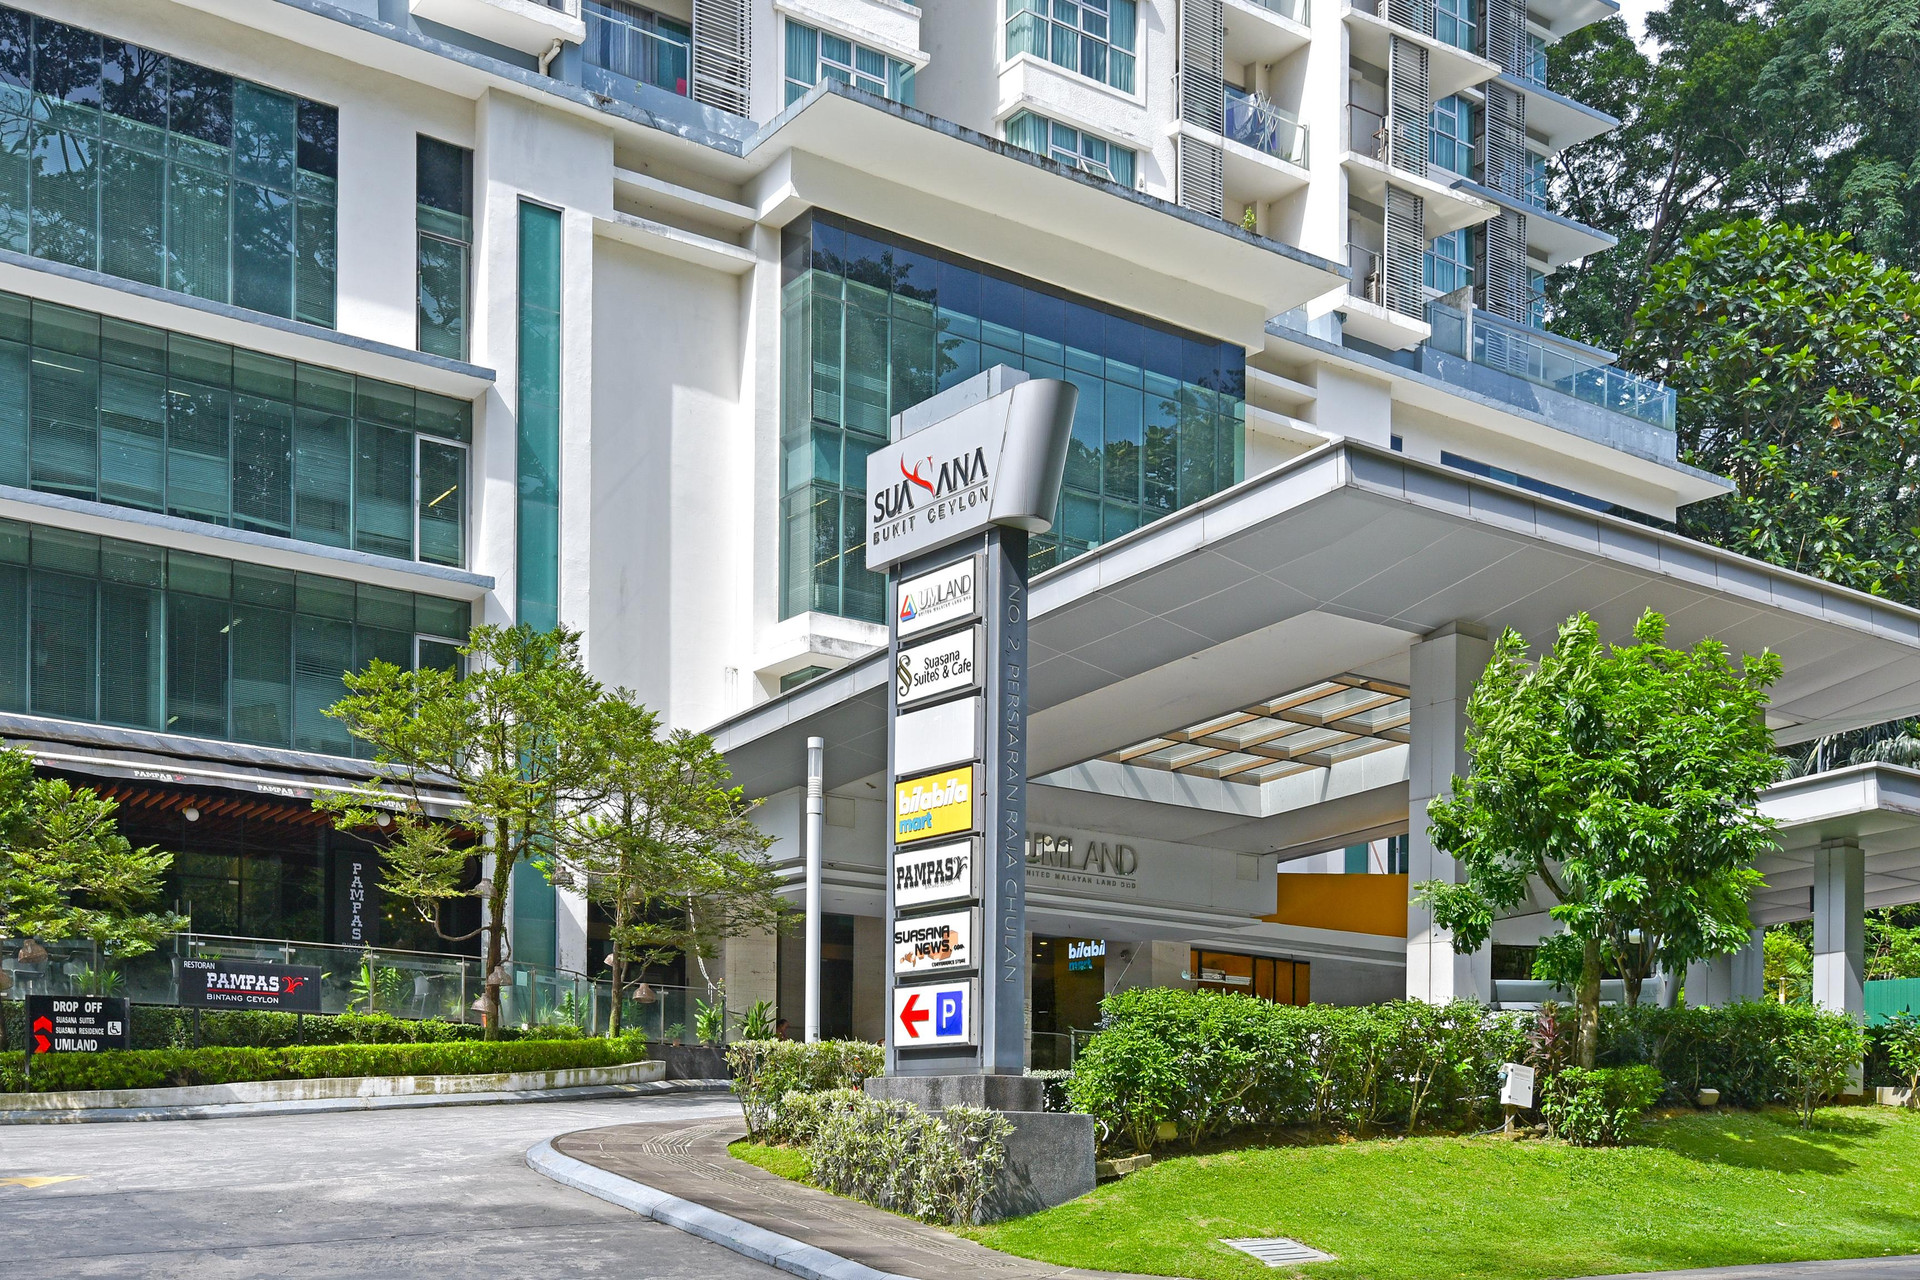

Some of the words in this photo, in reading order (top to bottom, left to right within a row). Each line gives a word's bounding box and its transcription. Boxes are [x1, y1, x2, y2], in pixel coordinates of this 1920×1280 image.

[874, 446, 988, 524] SUASANA
[873, 515, 916, 546] BUKIT
[928, 486, 989, 523] CEYLON
[919, 574, 972, 610] UMLAND
[1008, 584, 1020, 627] NO.
[1005, 636, 1020, 656] 2,
[924, 650, 960, 670] Suasana
[942, 664, 949, 678] &
[952, 658, 972, 675] Cafe
[1006, 663, 1020, 802] PERSIARAN
[134, 770, 173, 780] PAMPAS
[257, 785, 293, 794] PAMPAS
[899, 778, 968, 815] bilabila
[899, 812, 932, 834] mart
[1006, 810, 1018, 869] RAJA
[1025, 832, 1138, 876] UMLAND
[897, 857, 953, 890] PAMPAS
[1026, 870, 1050, 878] NITED
[1054, 874, 1092, 883] MALAYAN
[1096, 878, 1116, 886] LAND
[350, 862, 364, 940] PAMPAS
[895, 925, 950, 944] SUASANA
[1004, 878, 1018, 983] CHULAN
[183, 960, 215, 970] RESTORAN
[1069, 959, 1093, 971] mart
[206, 972, 280, 992] PAMPAS
[53, 1001, 79, 1013] DROP
[85, 1002, 102, 1013] OFF
[206, 994, 243, 1002] BINTANG
[246, 995, 279, 1004] CEYLON
[943, 999, 956, 1028] P
[54, 1039, 98, 1052] UMLAND
